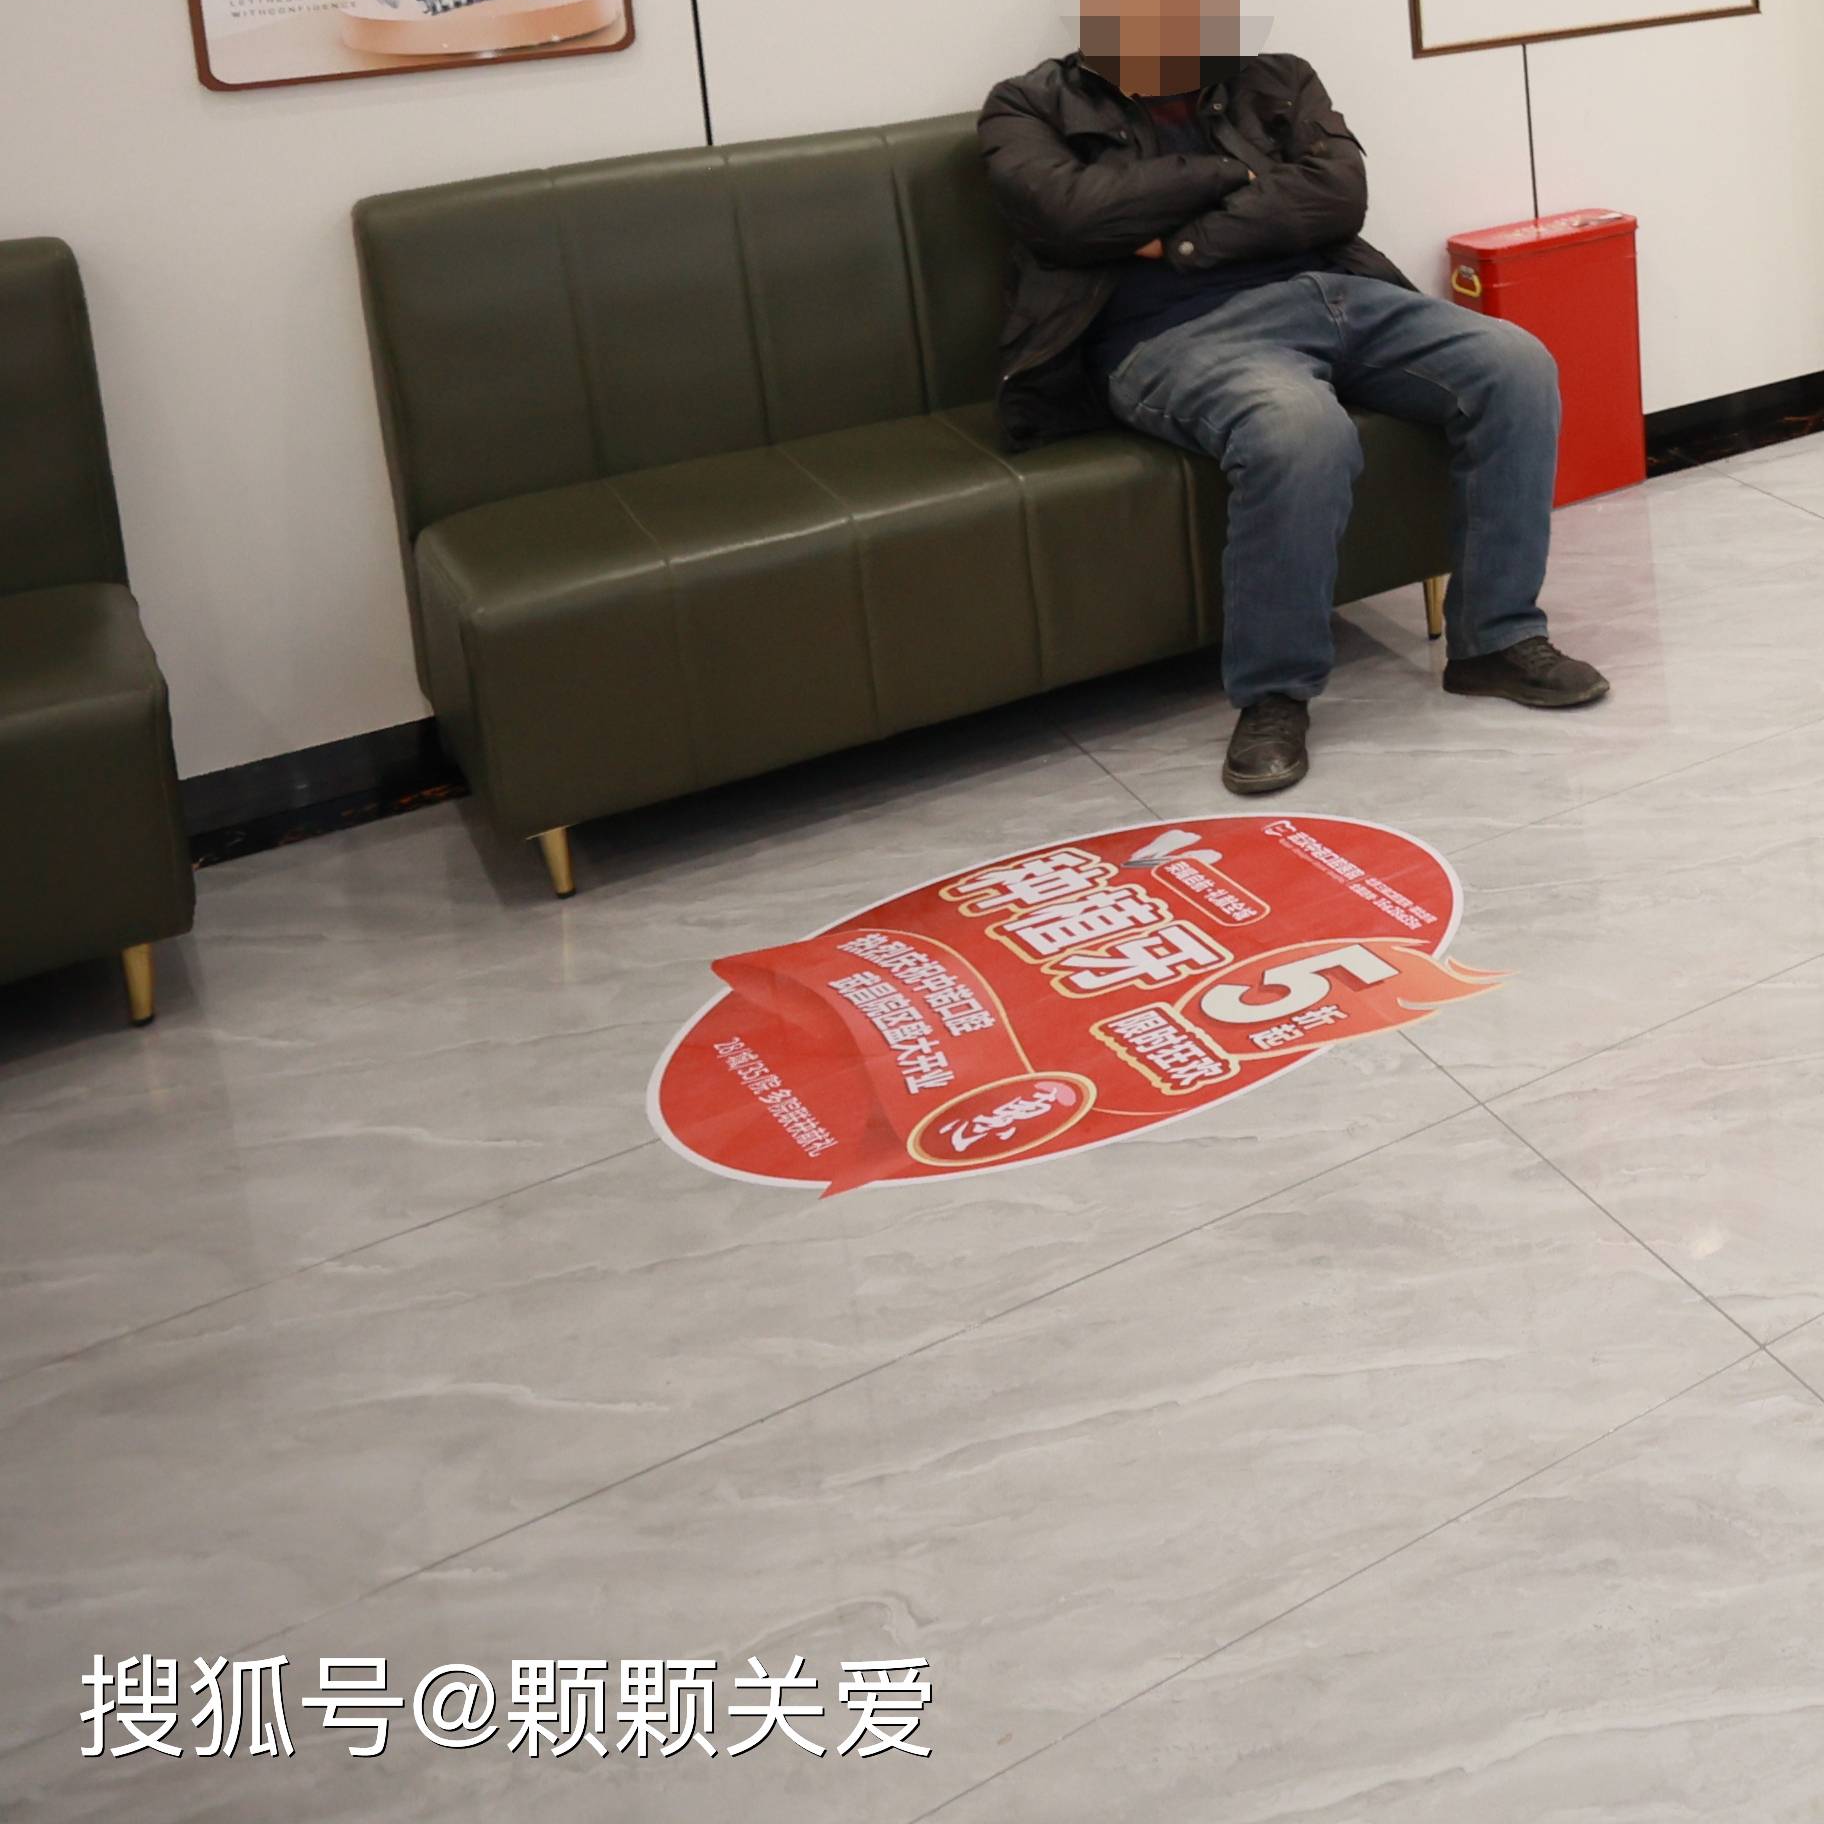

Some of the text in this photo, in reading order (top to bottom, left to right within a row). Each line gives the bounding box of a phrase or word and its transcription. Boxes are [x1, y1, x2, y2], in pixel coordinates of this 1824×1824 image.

[956, 850, 1221, 992] 种植牙
[828, 971, 954, 1095] 武昌院区盛大开业
[836, 932, 996, 1037] 热烈庆祝中诺口腔
[1199, 943, 1403, 1025] 5
[1106, 1007, 1229, 1088] 限时狂欢
